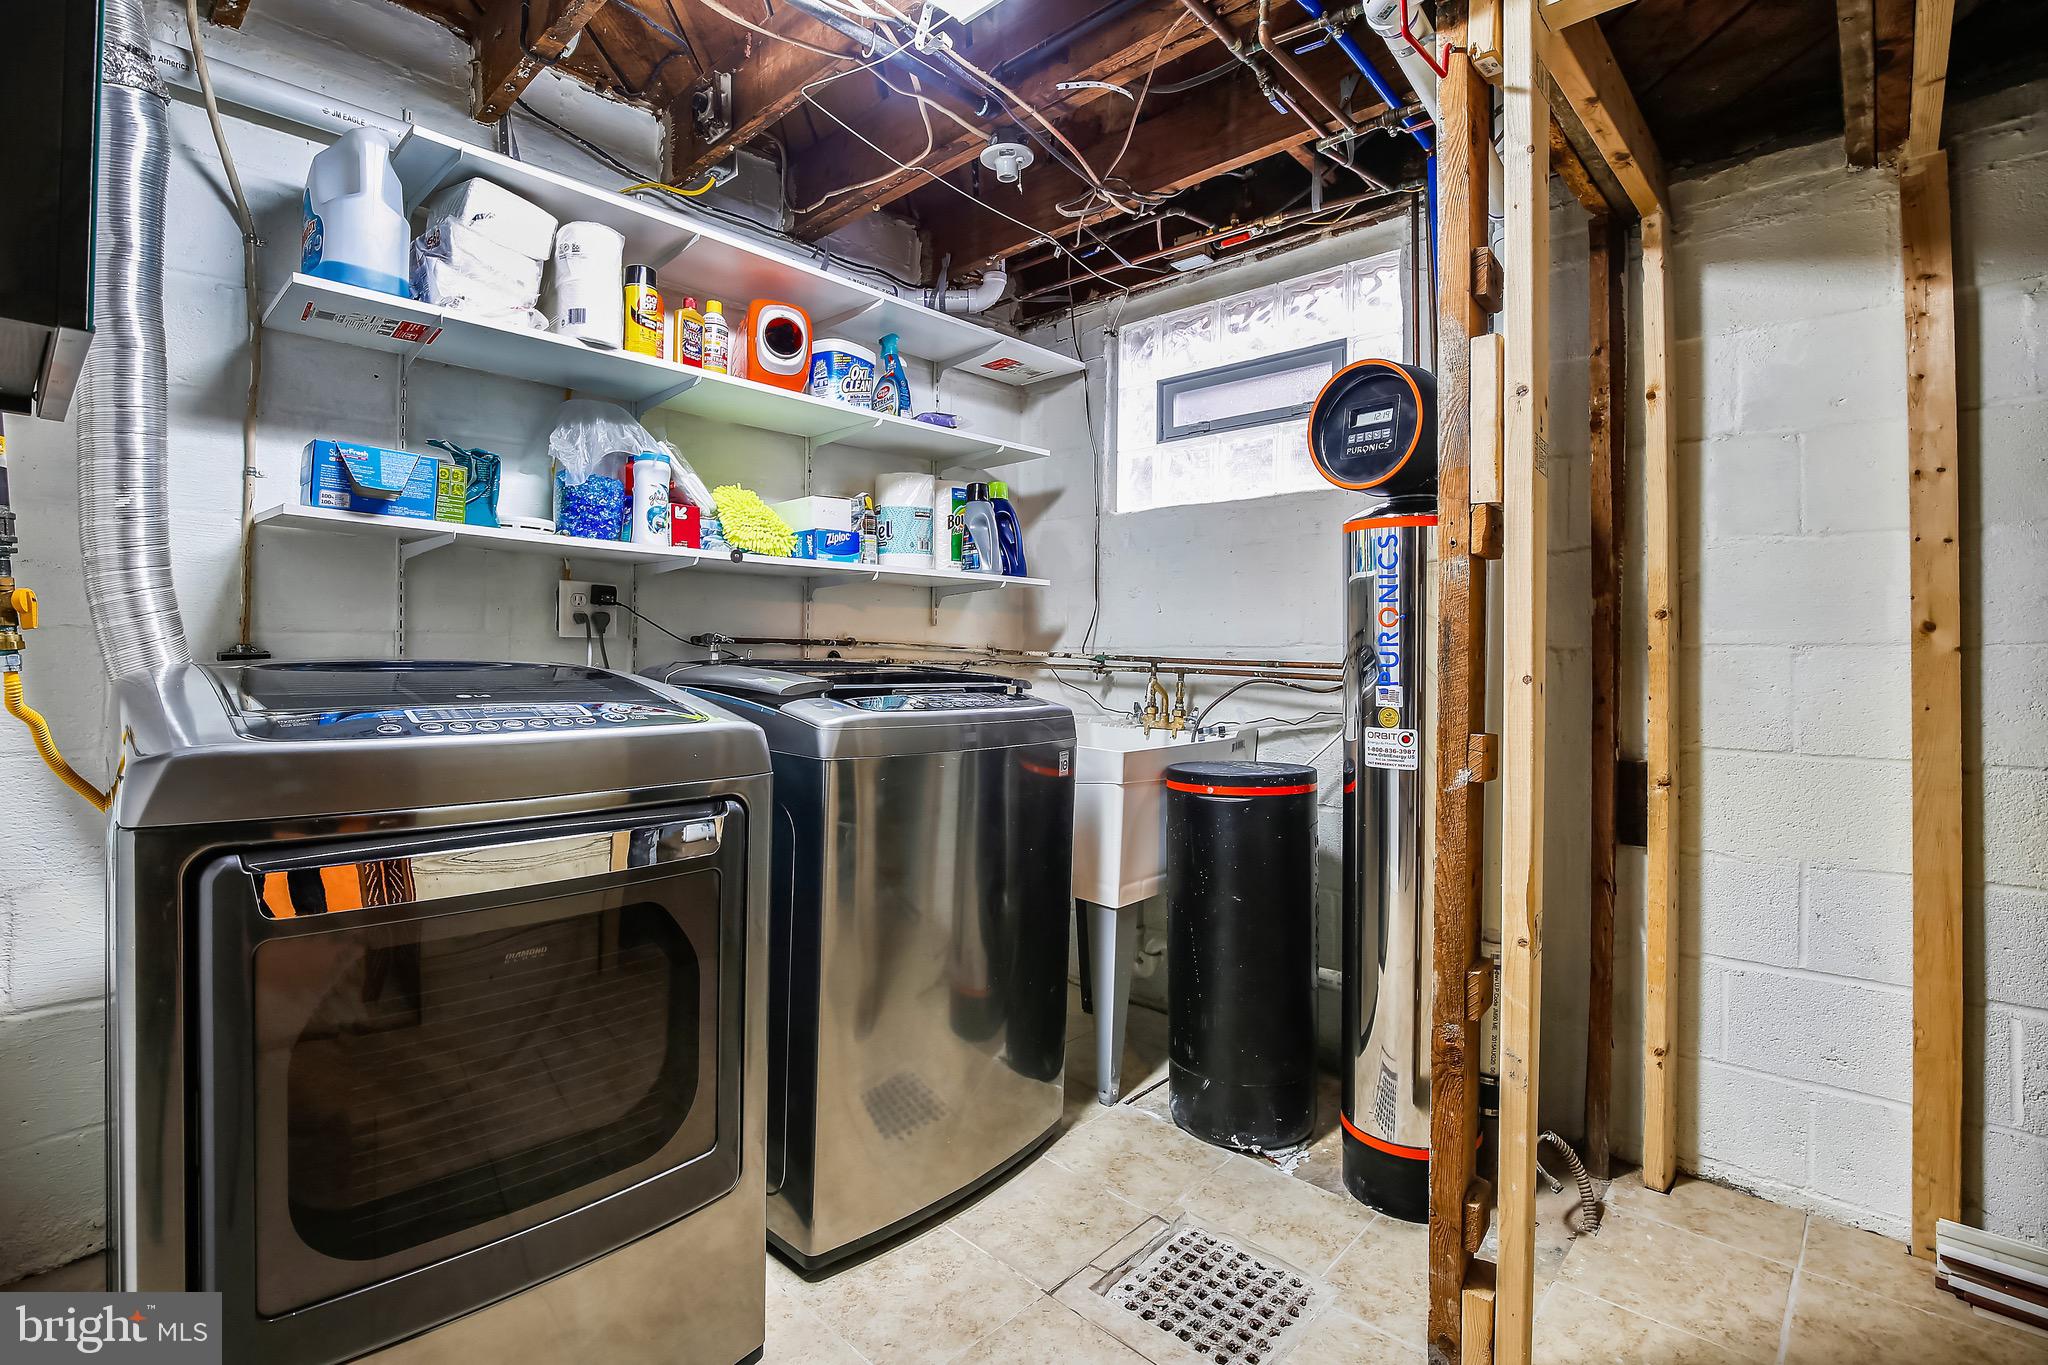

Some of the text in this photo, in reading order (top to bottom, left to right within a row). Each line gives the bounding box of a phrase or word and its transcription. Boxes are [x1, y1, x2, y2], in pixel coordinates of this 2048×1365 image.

[158, 55, 190, 71] America
[331, 109, 366, 127] JM EAGLE
[843, 377, 872, 392] CLEAN
[1346, 442, 1390, 456] PURONICS
[878, 520, 892, 539] el
[826, 532, 851, 547] Ziploc
[1377, 534, 1399, 686] PURONICS
[1367, 731, 1398, 741] ORBIT
[1367, 746, 1416, 755] 1-800-836-3987
